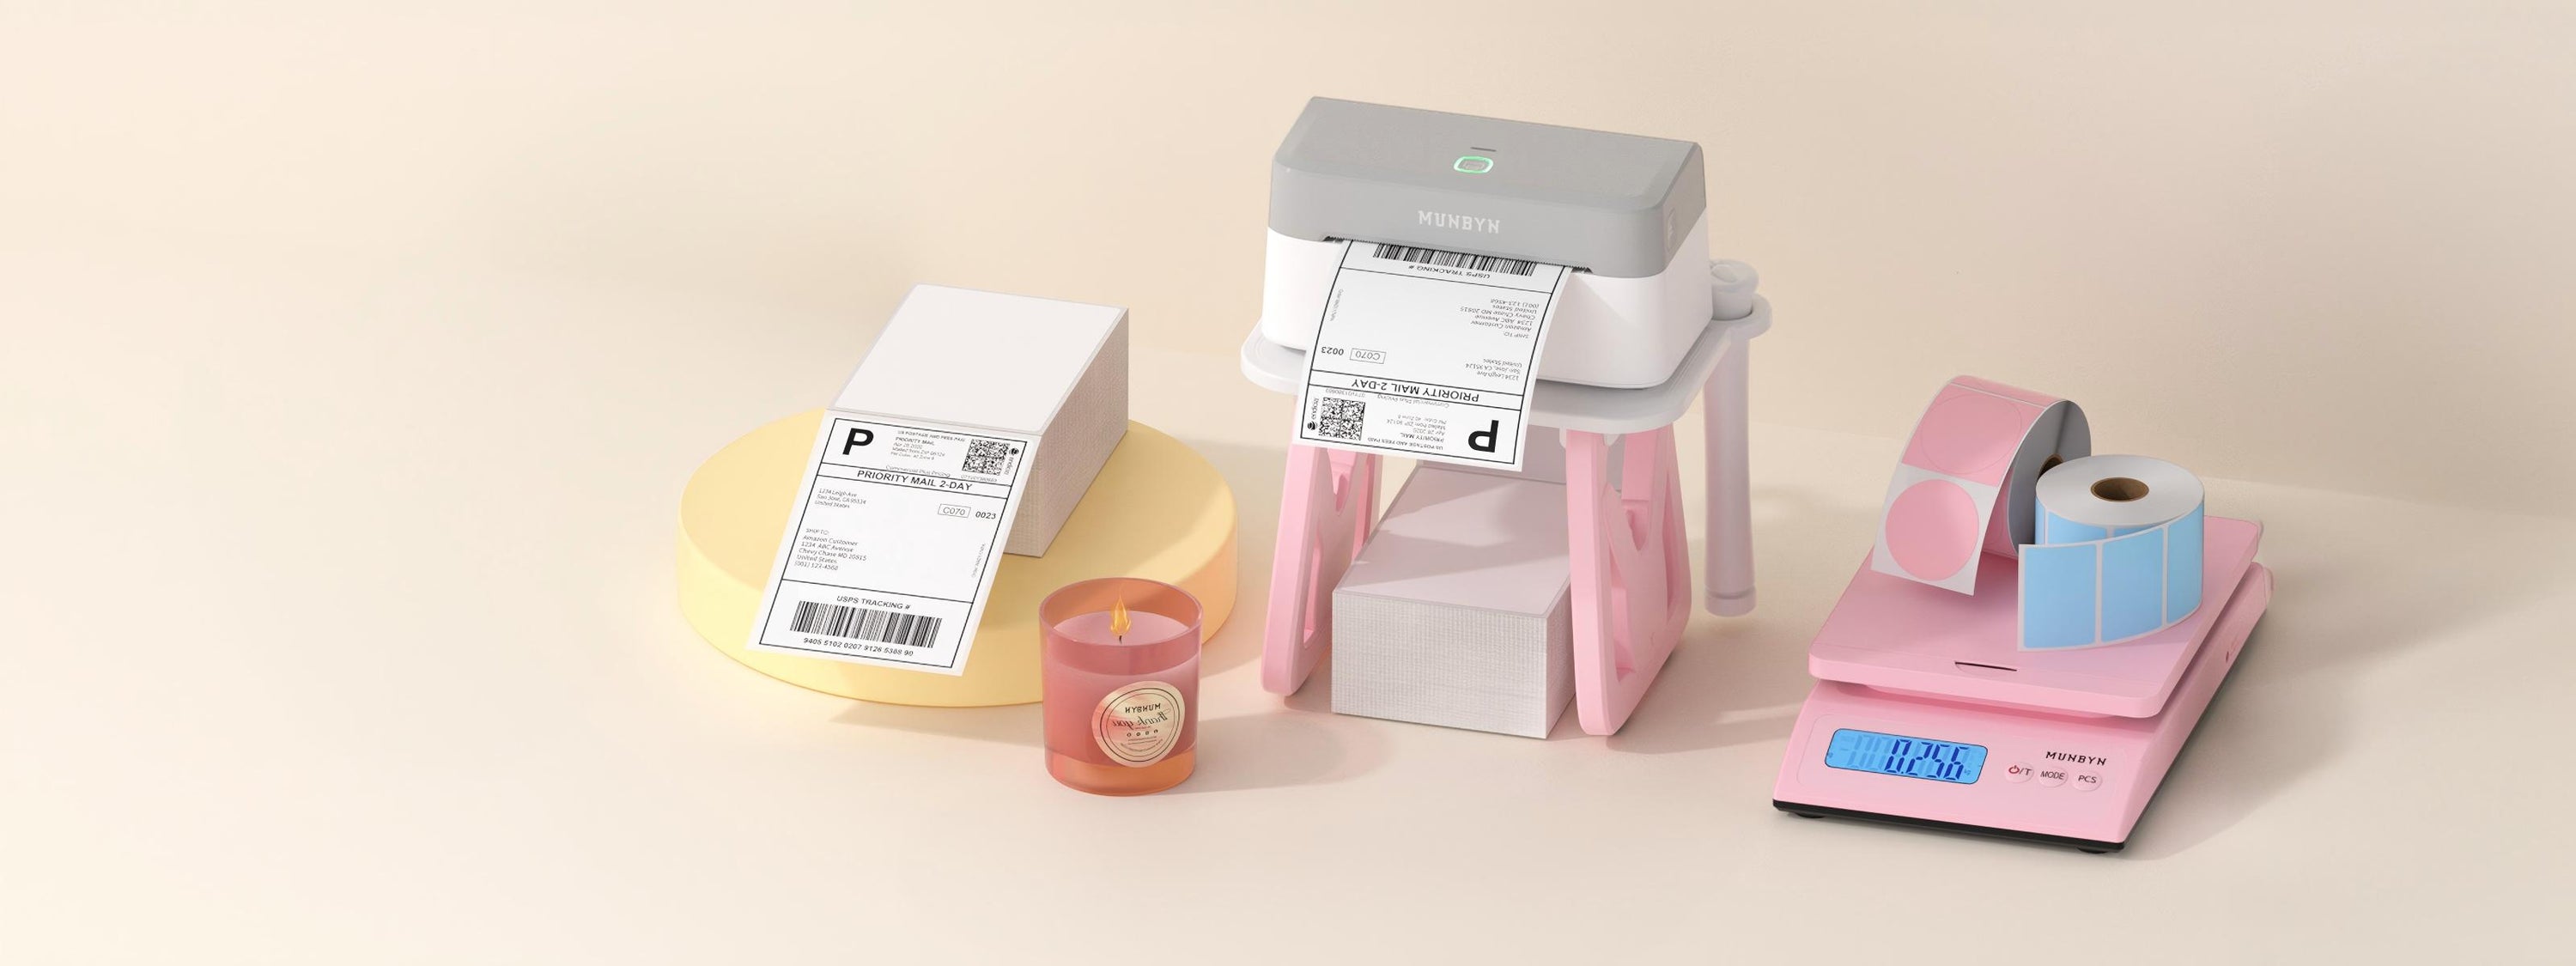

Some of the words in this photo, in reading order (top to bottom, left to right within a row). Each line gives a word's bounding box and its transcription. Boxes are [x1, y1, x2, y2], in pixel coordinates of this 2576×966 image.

[1418, 210, 1501, 234] MUNBYN
[1417, 265, 1463, 276] TRACKING
[1470, 320, 1504, 329] Customer
[1321, 346, 1345, 355] 0023
[1355, 350, 1381, 361] C070
[1352, 379, 1388, 392] 2-DAY
[1391, 384, 1419, 394] MAIL
[1423, 387, 1479, 402] PRIORITY
[842, 428, 874, 455] P
[1467, 420, 1499, 453] P
[858, 470, 909, 483] PRIORITY
[910, 477, 937, 487] MAIL
[939, 481, 973, 491] 2-DAY
[944, 507, 965, 516] C070
[862, 598, 903, 609] TRACKING
[1885, 739, 1970, 781] 0.256
[2046, 751, 2107, 766] MUNBYN
[2040, 771, 2065, 781] MODE
[2079, 775, 2098, 784] PCS
